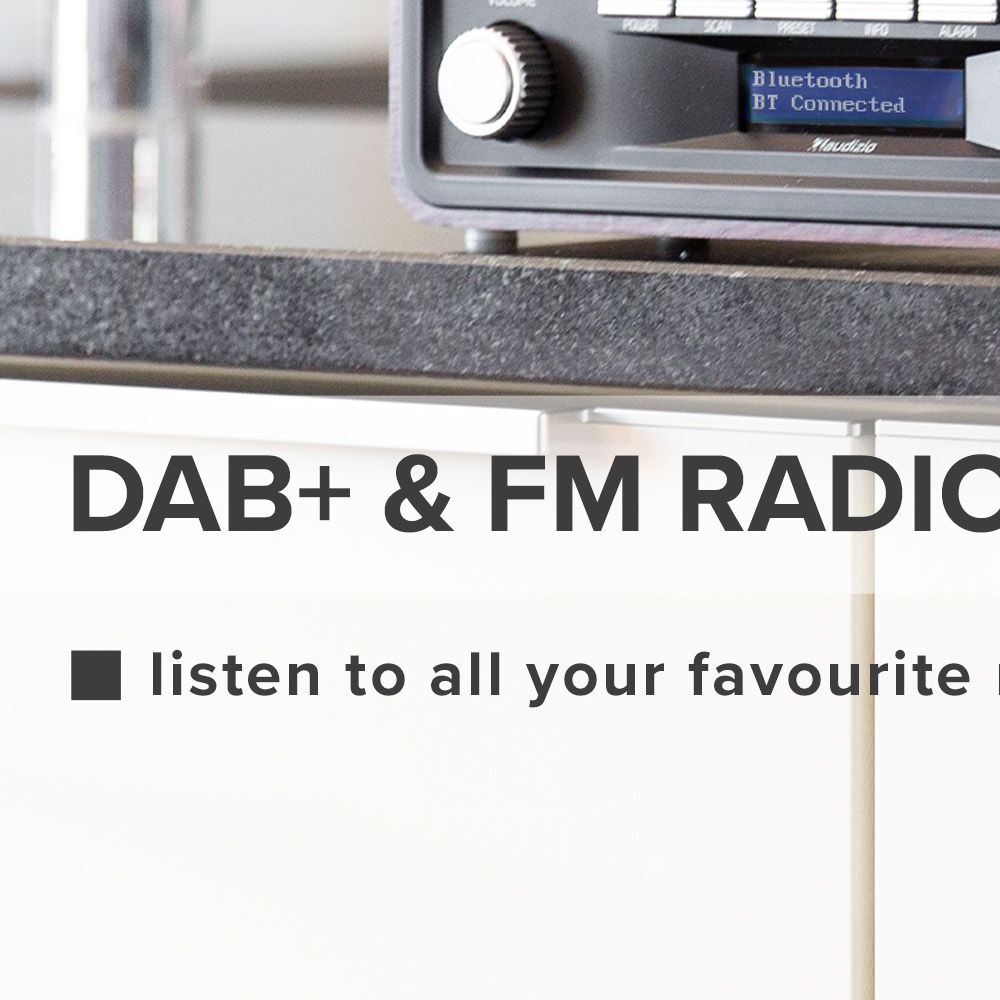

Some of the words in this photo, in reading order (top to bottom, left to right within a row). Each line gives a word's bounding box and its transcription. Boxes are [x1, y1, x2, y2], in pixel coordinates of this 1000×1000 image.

[622, 17, 660, 32] POWER
[703, 19, 733, 33] SCAN
[776, 21, 817, 35] PRESET
[863, 23, 890, 37] INFO
[937, 25, 978, 39] ALARM
[751, 70, 869, 90] Bluetooth
[751, 93, 779, 112] BT
[790, 95, 907, 114] Connected
